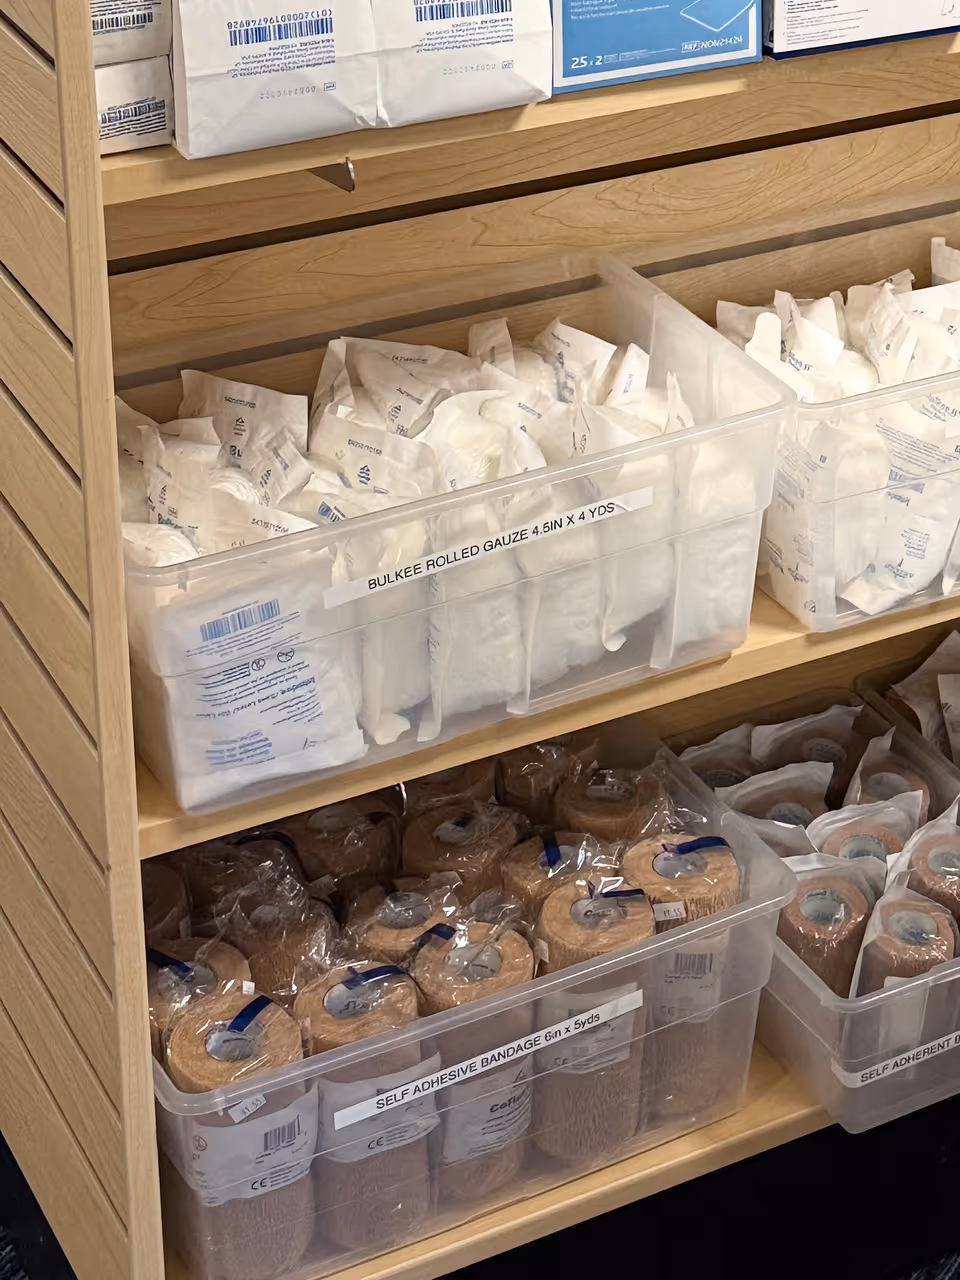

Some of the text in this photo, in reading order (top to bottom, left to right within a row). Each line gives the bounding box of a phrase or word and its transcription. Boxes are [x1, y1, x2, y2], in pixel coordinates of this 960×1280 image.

[572, 56, 603, 68] 25 2
[368, 563, 422, 590] BULKEE
[426, 545, 480, 571] ROLLED
[483, 529, 528, 552] GAUZE
[566, 514, 575, 526] X
[578, 511, 586, 522] 4
[588, 502, 615, 518] YDS
[376, 1088, 411, 1109] SELF
[413, 1061, 478, 1095] ADHESIVE
[481, 1035, 542, 1067] BANDAGE
[573, 1012, 600, 1032] 5yds
[861, 1066, 889, 1083] SELF
[892, 1037, 952, 1069] ADHERENT
